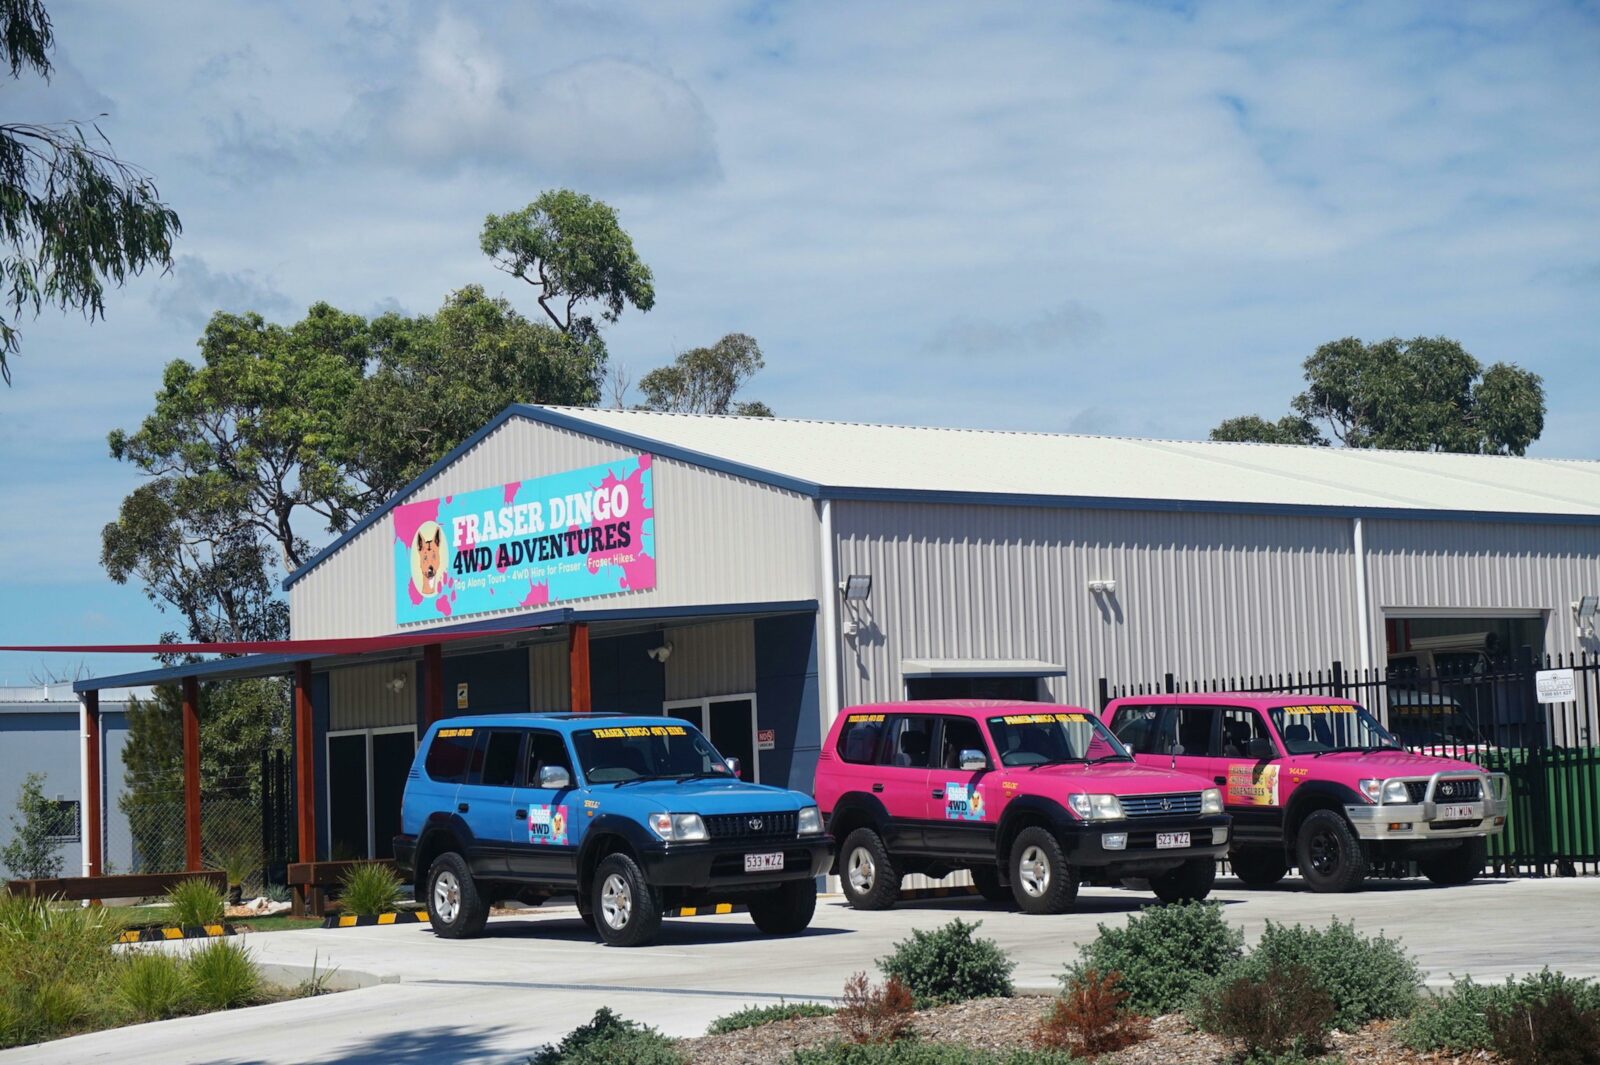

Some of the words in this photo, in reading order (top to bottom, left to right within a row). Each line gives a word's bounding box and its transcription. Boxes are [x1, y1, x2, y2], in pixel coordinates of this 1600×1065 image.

[452, 501, 545, 547] FRASER
[549, 484, 629, 529] DINGO
[453, 546, 492, 575] 4WD
[496, 521, 631, 569] ADVENTURES
[453, 579, 466, 591] Tag
[467, 576, 486, 588] Along
[487, 574, 507, 585] Tours
[512, 569, 530, 581] 4WD
[531, 566, 545, 577] Hire
[547, 565, 557, 575] for
[559, 562, 581, 574] Fraser
[588, 557, 612, 569] Fraser
[613, 553, 636, 564] Hikes.
[592, 728, 625, 739] FRASER
[623, 727, 651, 737] DINGO
[650, 727, 668, 736] 4WD
[665, 726, 687, 736] HIRE
[1230, 787, 1265, 797] ADVENTURES
[948, 800, 967, 811] 4WD
[1459, 806, 1472, 817] WUN
[531, 823, 550, 835] 4WD
[1173, 832, 1190, 844] WZZ
[746, 855, 762, 868] 533
[764, 854, 782, 866] WZZ
